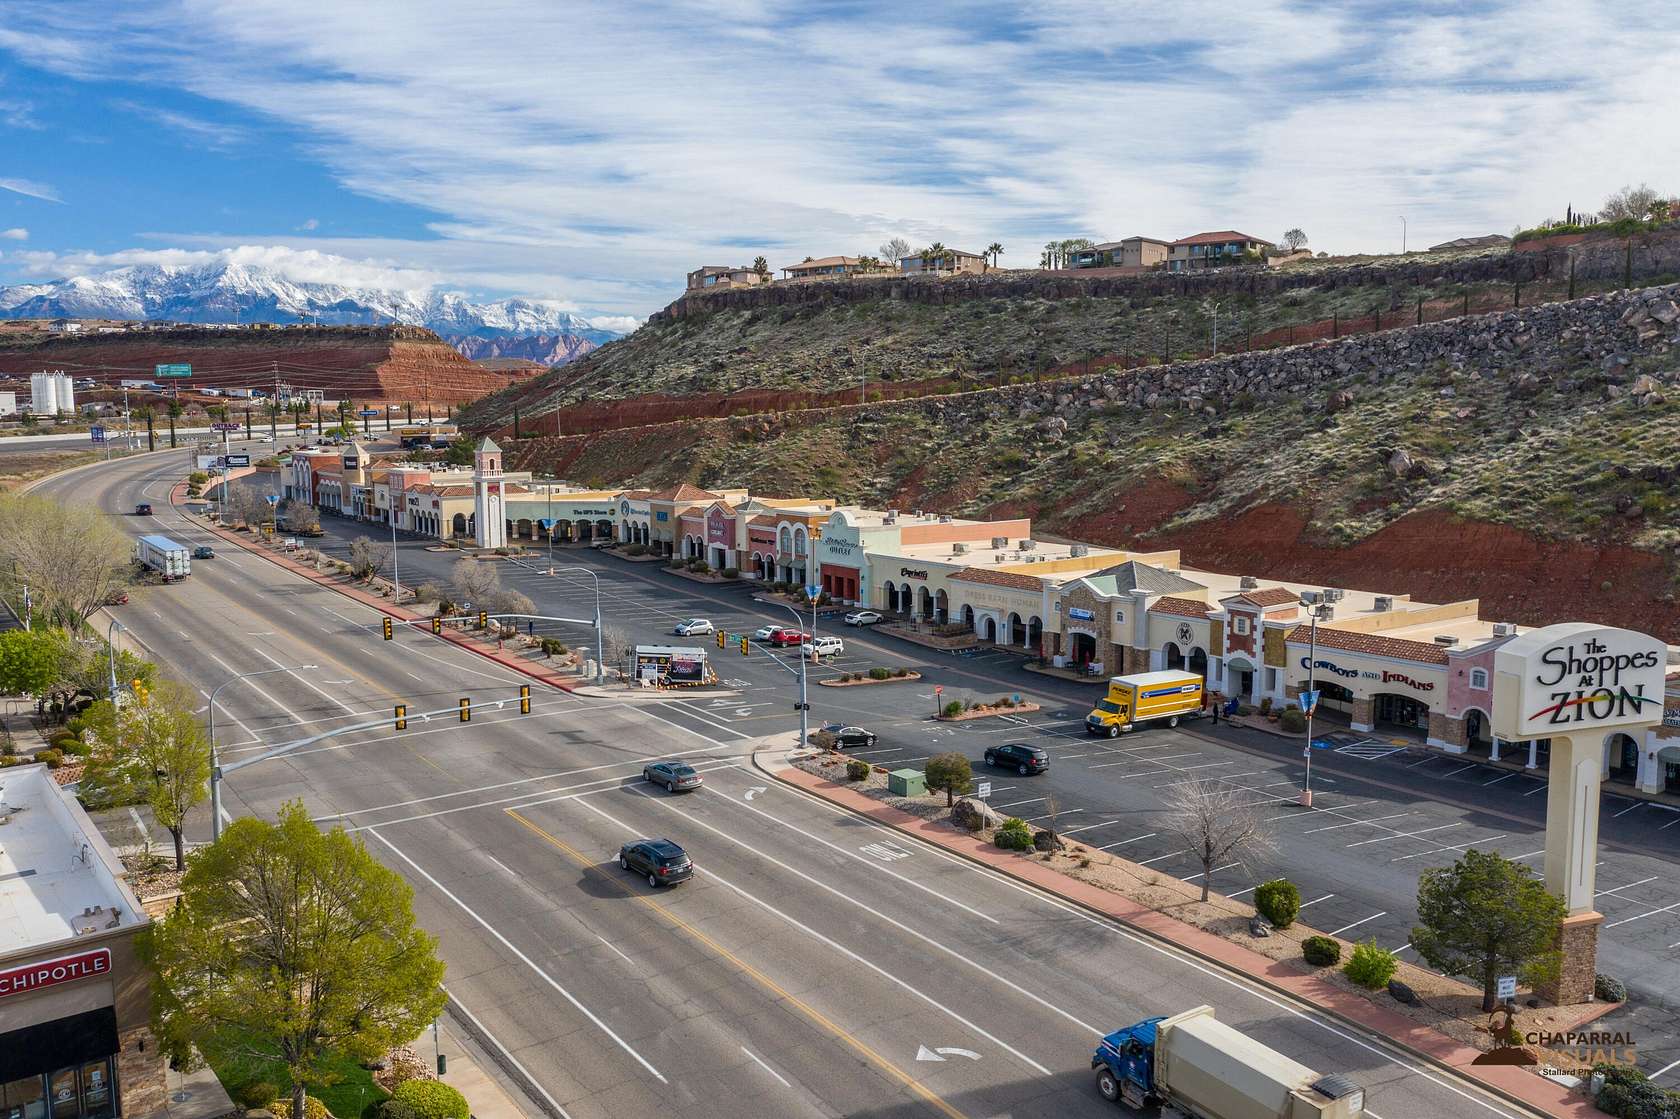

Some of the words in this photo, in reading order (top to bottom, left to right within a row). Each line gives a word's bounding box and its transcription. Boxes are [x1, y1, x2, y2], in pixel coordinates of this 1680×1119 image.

[1584, 638, 1606, 654] The
[1537, 646, 1658, 687] Shoppes
[1382, 670, 1434, 690] INDIANS
[1578, 675, 1593, 687] At
[1549, 684, 1645, 724] ZION
[859, 840, 915, 861] ONLY
[0, 957, 105, 992] CHIPOTLE
